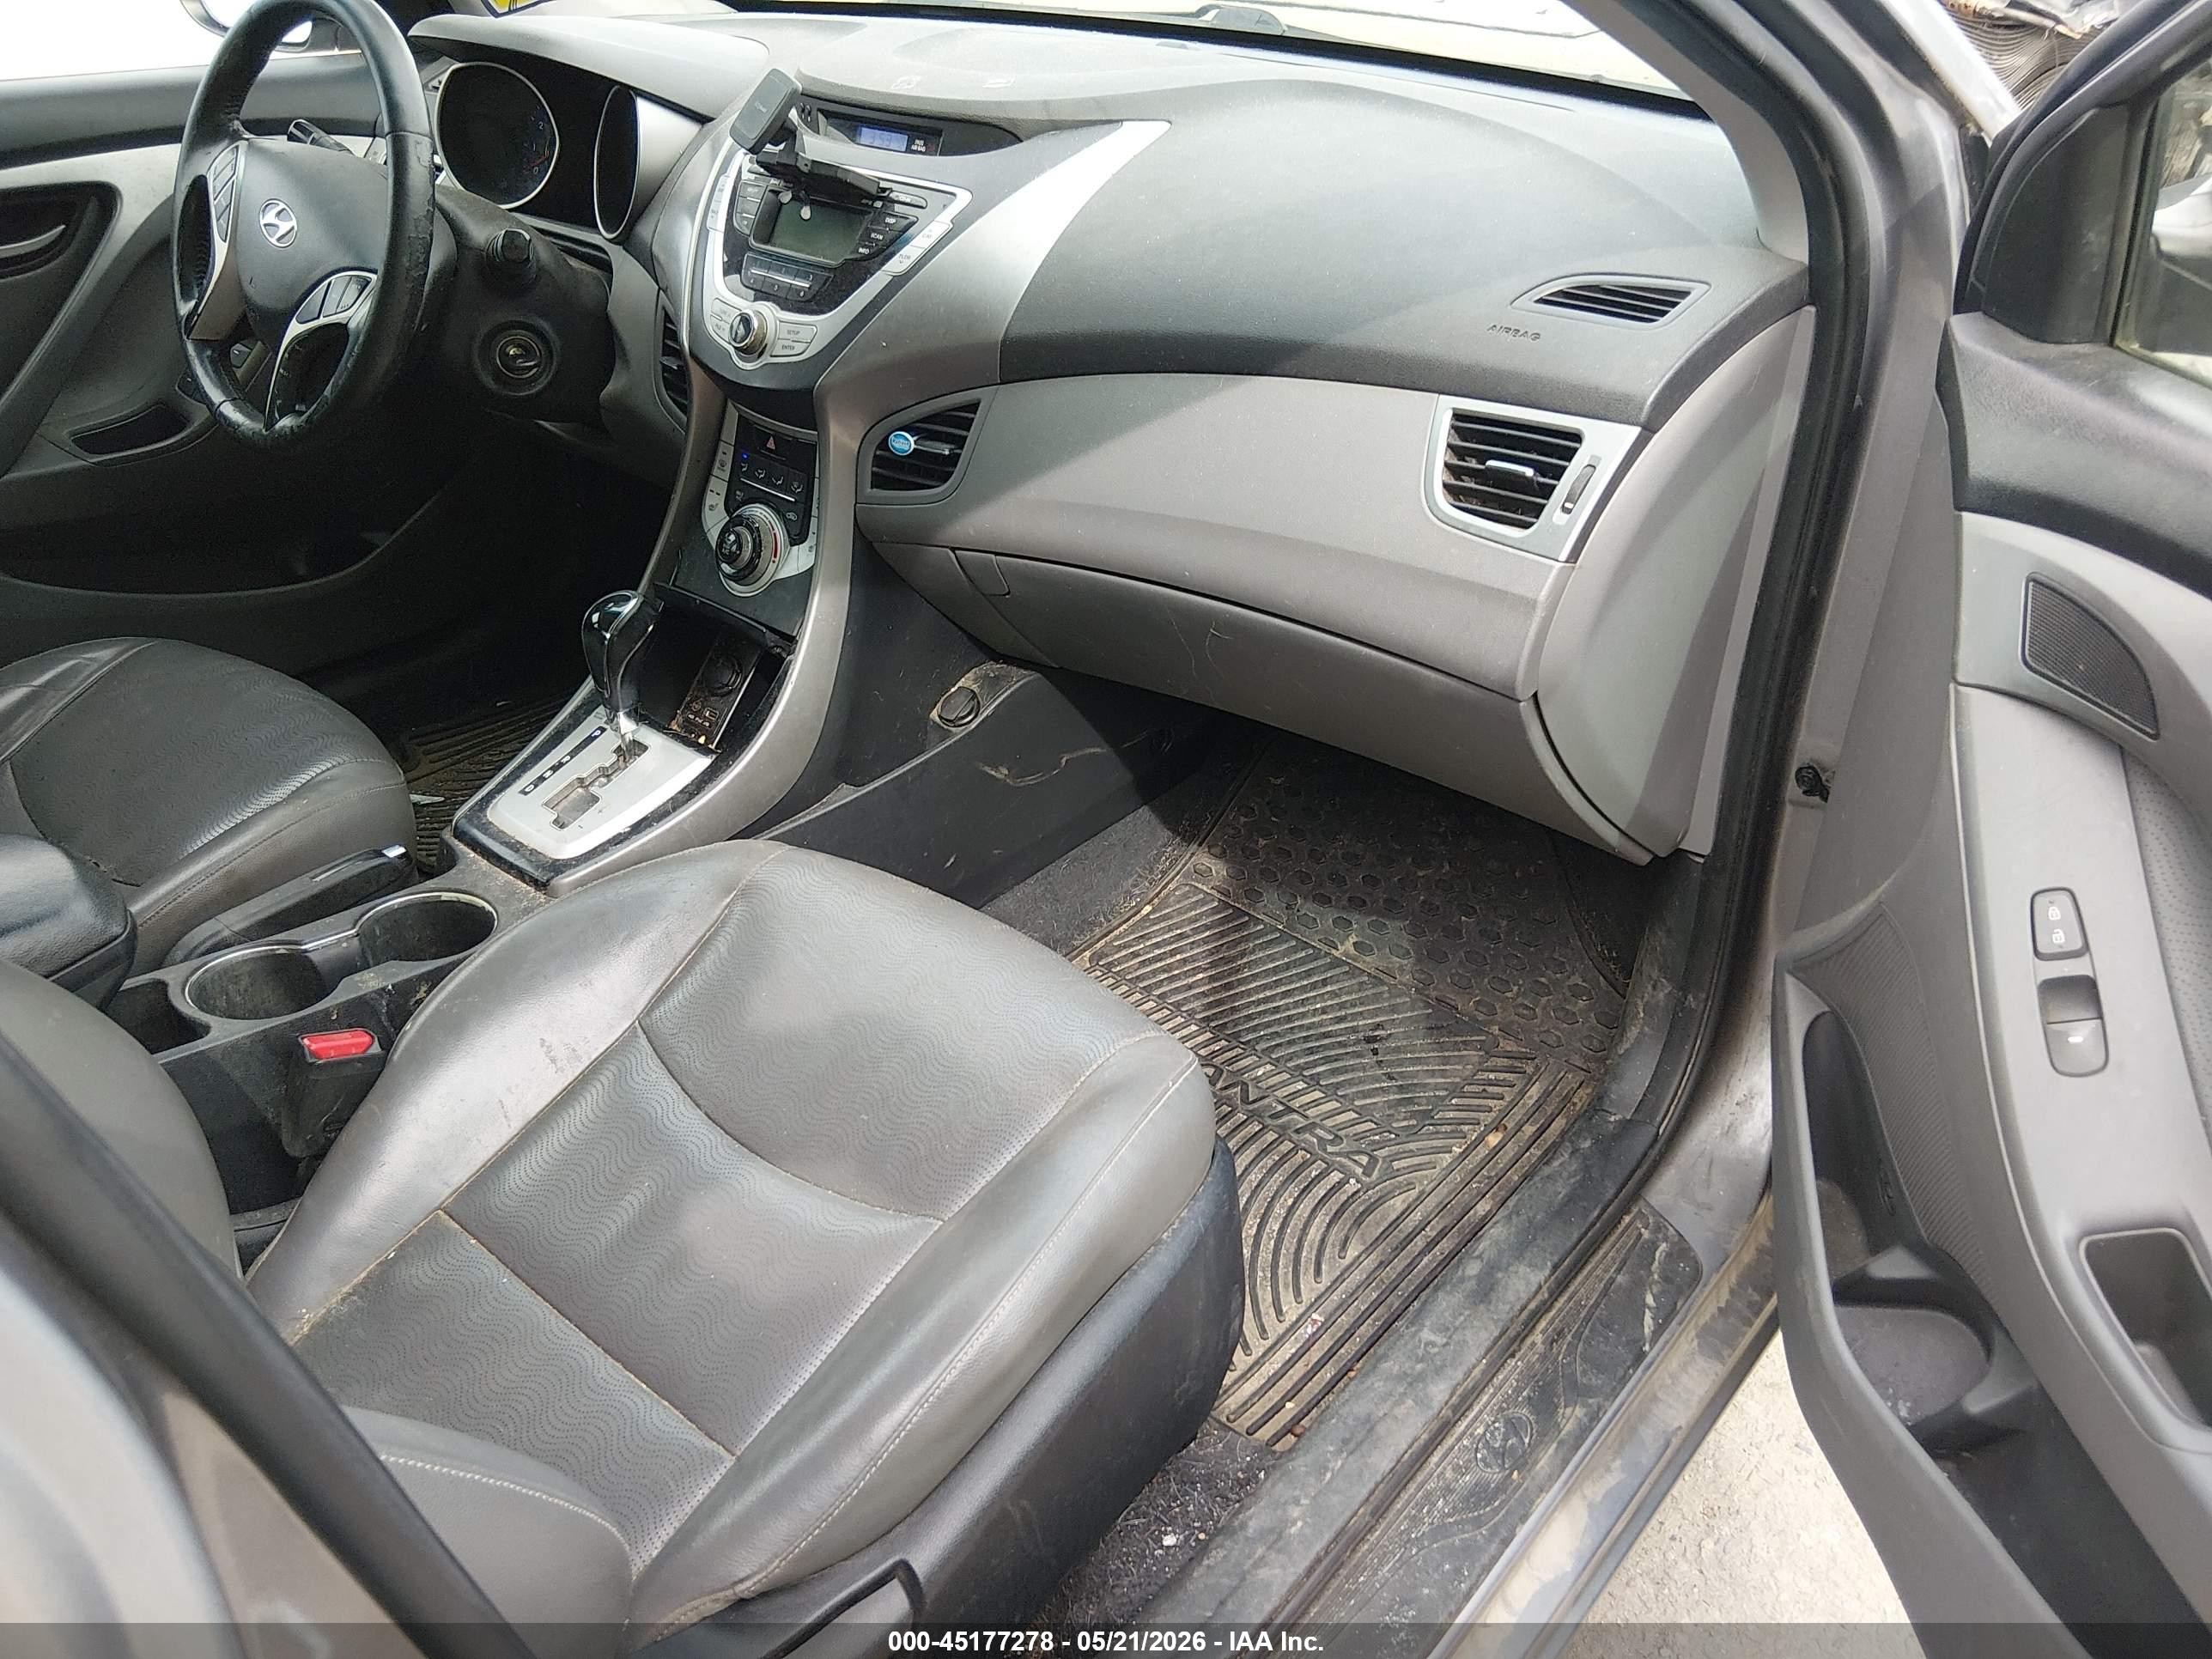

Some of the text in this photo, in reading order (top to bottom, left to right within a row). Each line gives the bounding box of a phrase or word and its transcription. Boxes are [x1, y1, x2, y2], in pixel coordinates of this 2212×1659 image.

[1486, 324, 1541, 342] AIRBAG
[561, 755, 571, 764] R
[543, 769, 554, 779] N
[525, 784, 534, 793] D
